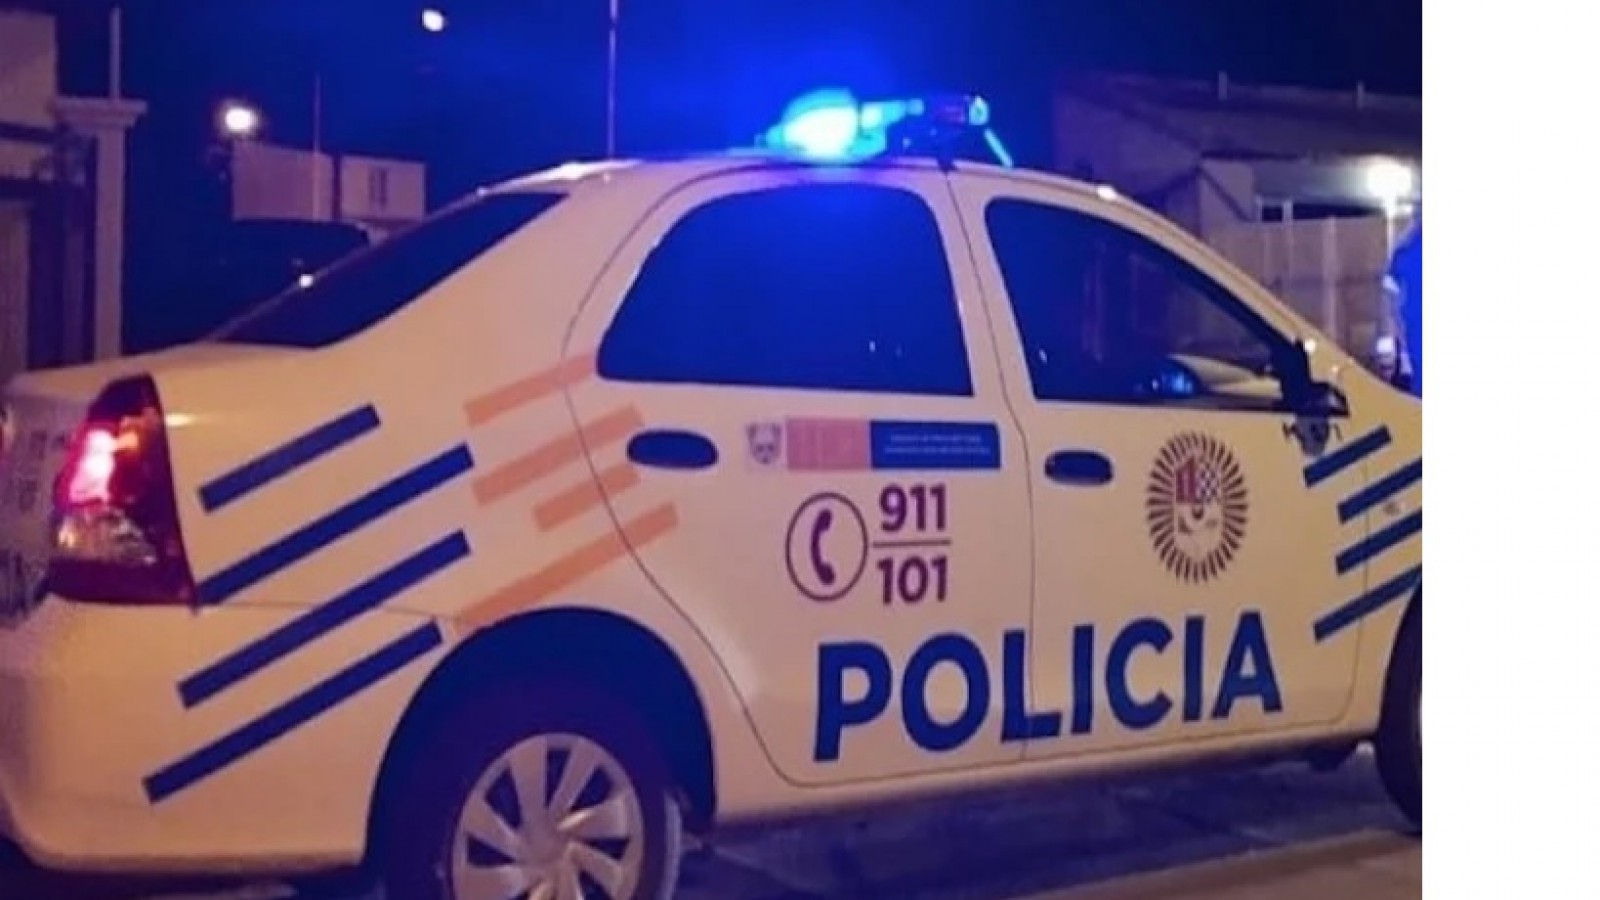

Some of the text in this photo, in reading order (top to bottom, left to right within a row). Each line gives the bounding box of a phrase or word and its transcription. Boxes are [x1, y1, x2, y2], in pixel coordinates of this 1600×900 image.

[878, 484, 947, 532] 911
[877, 556, 948, 605] 101
[814, 612, 1283, 762] POLICIA
